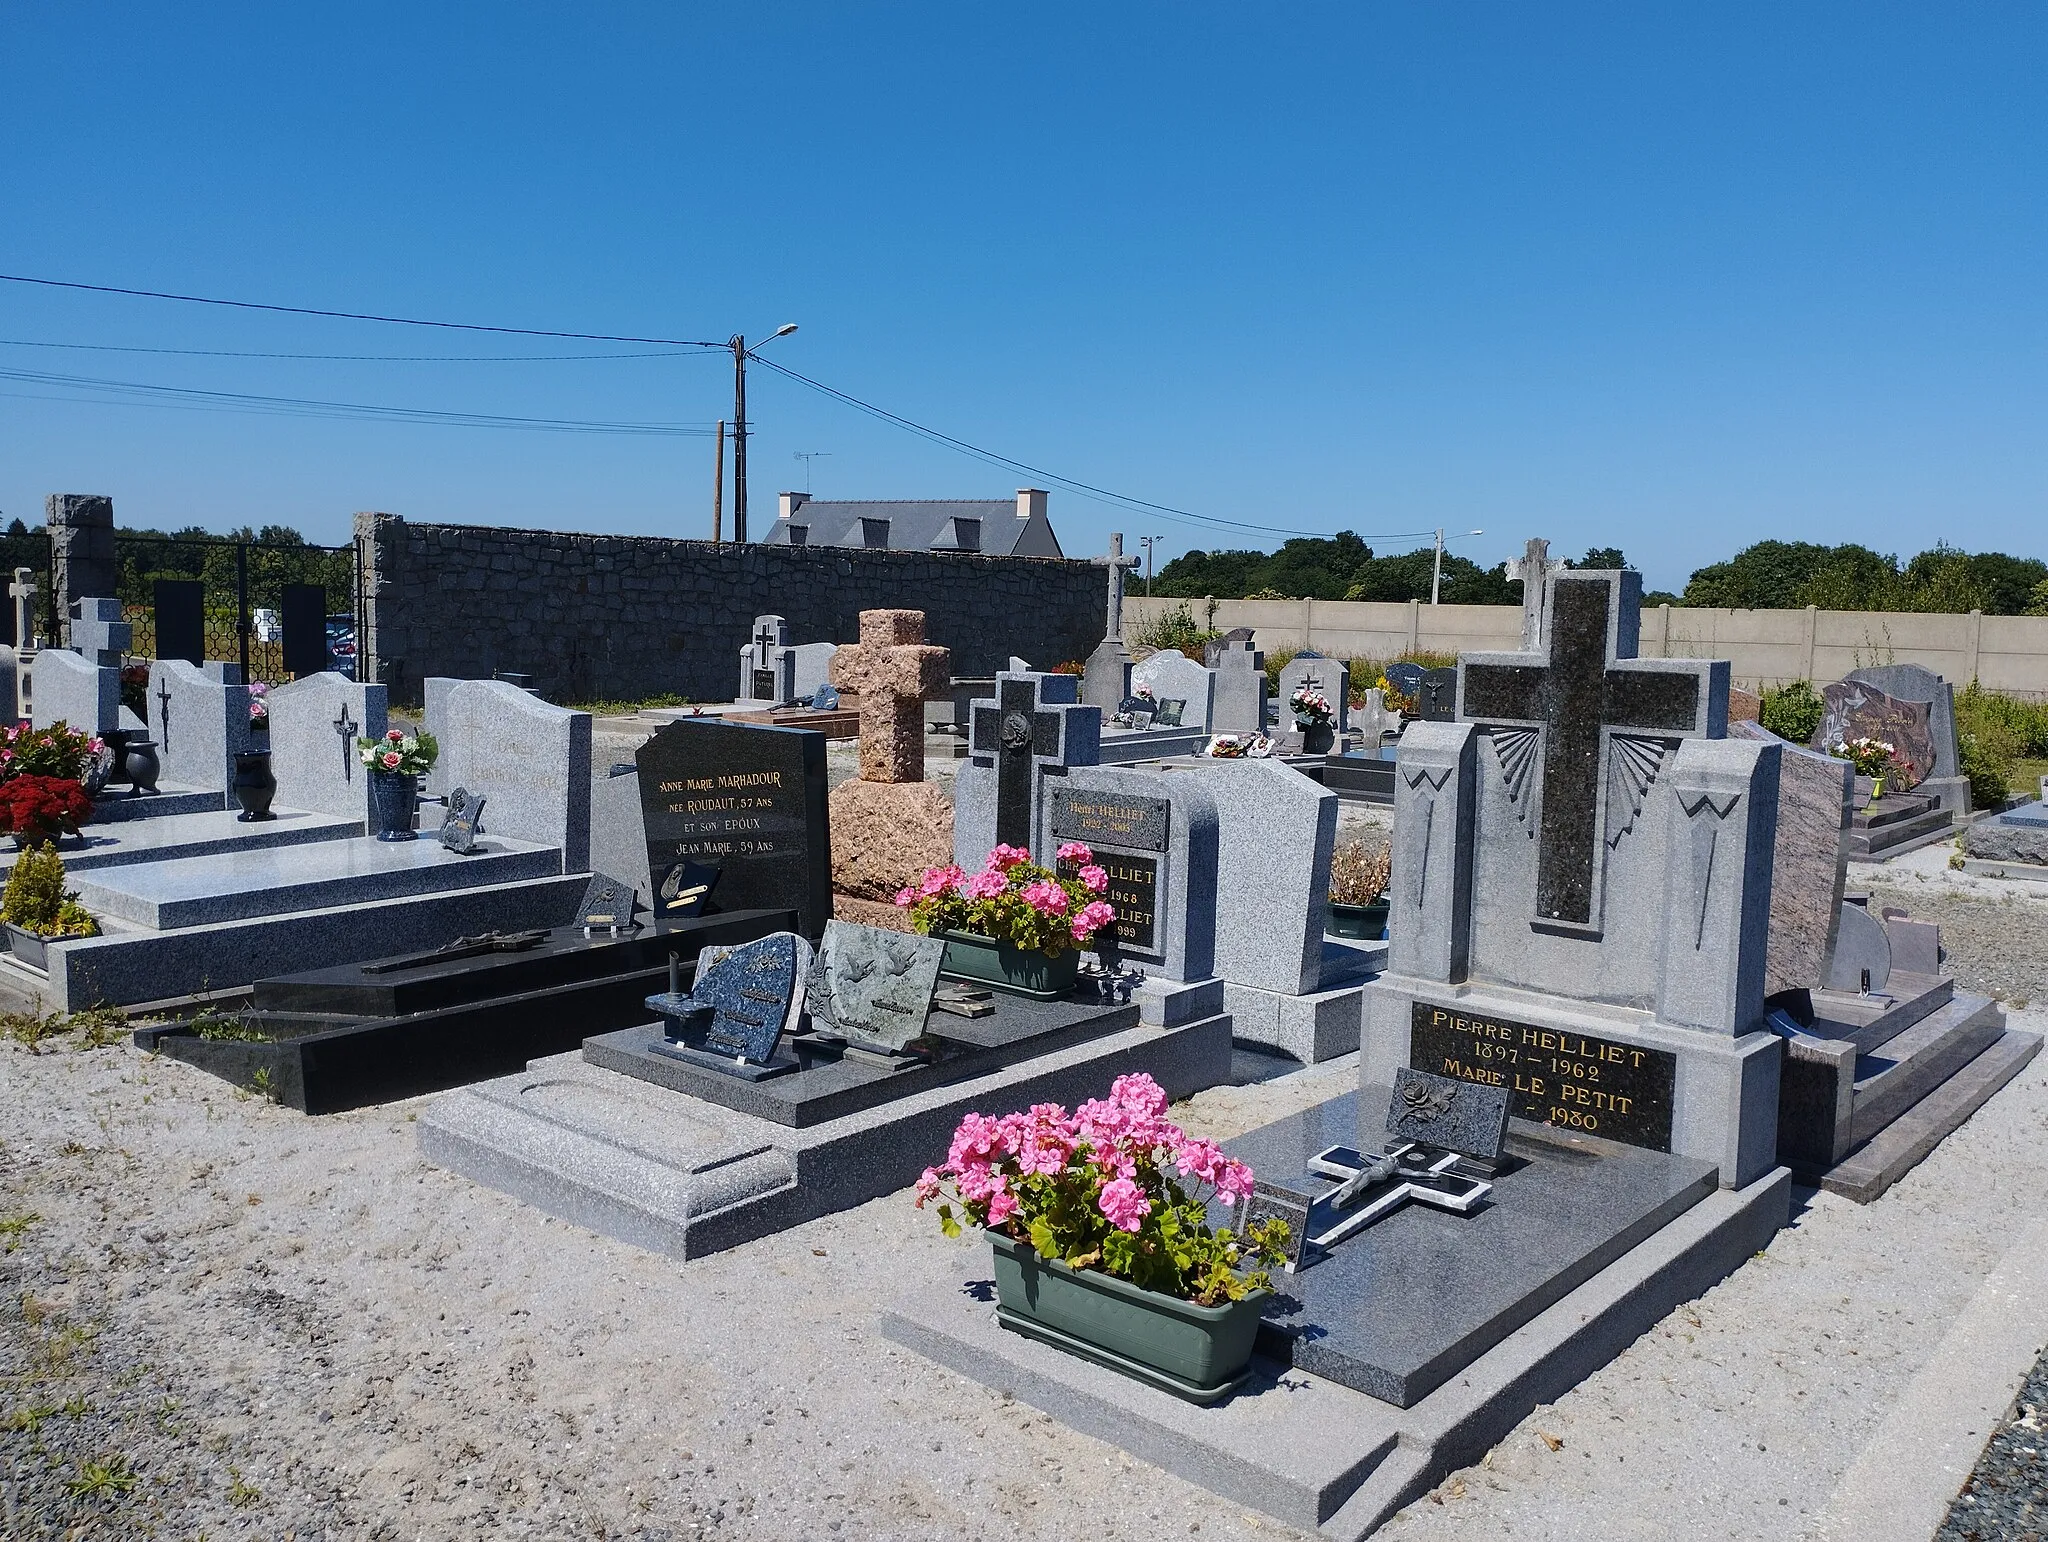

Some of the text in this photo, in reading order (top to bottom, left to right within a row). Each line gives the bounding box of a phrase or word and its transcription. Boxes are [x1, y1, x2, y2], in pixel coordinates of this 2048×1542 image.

[718, 771, 782, 790] MARHADOUR
[741, 798, 753, 809] 57
[1099, 805, 1147, 821] HELLIET
[684, 823, 695, 833] ET
[700, 822, 717, 832] SON
[740, 842, 753, 855] 59
[1095, 864, 1154, 884] LLIET
[1110, 889, 1137, 904] 1968
[1117, 908, 1153, 925] LIET
[1117, 925, 1136, 938] 999
[1433, 1010, 1645, 1068] PIERRE HELLIET
[1475, 1041, 1518, 1064] 1897
[1551, 1057, 1600, 1082] 1962
[1441, 1057, 1633, 1115] MARIE LE PETIT
[1550, 1106, 1598, 1130] 1980
